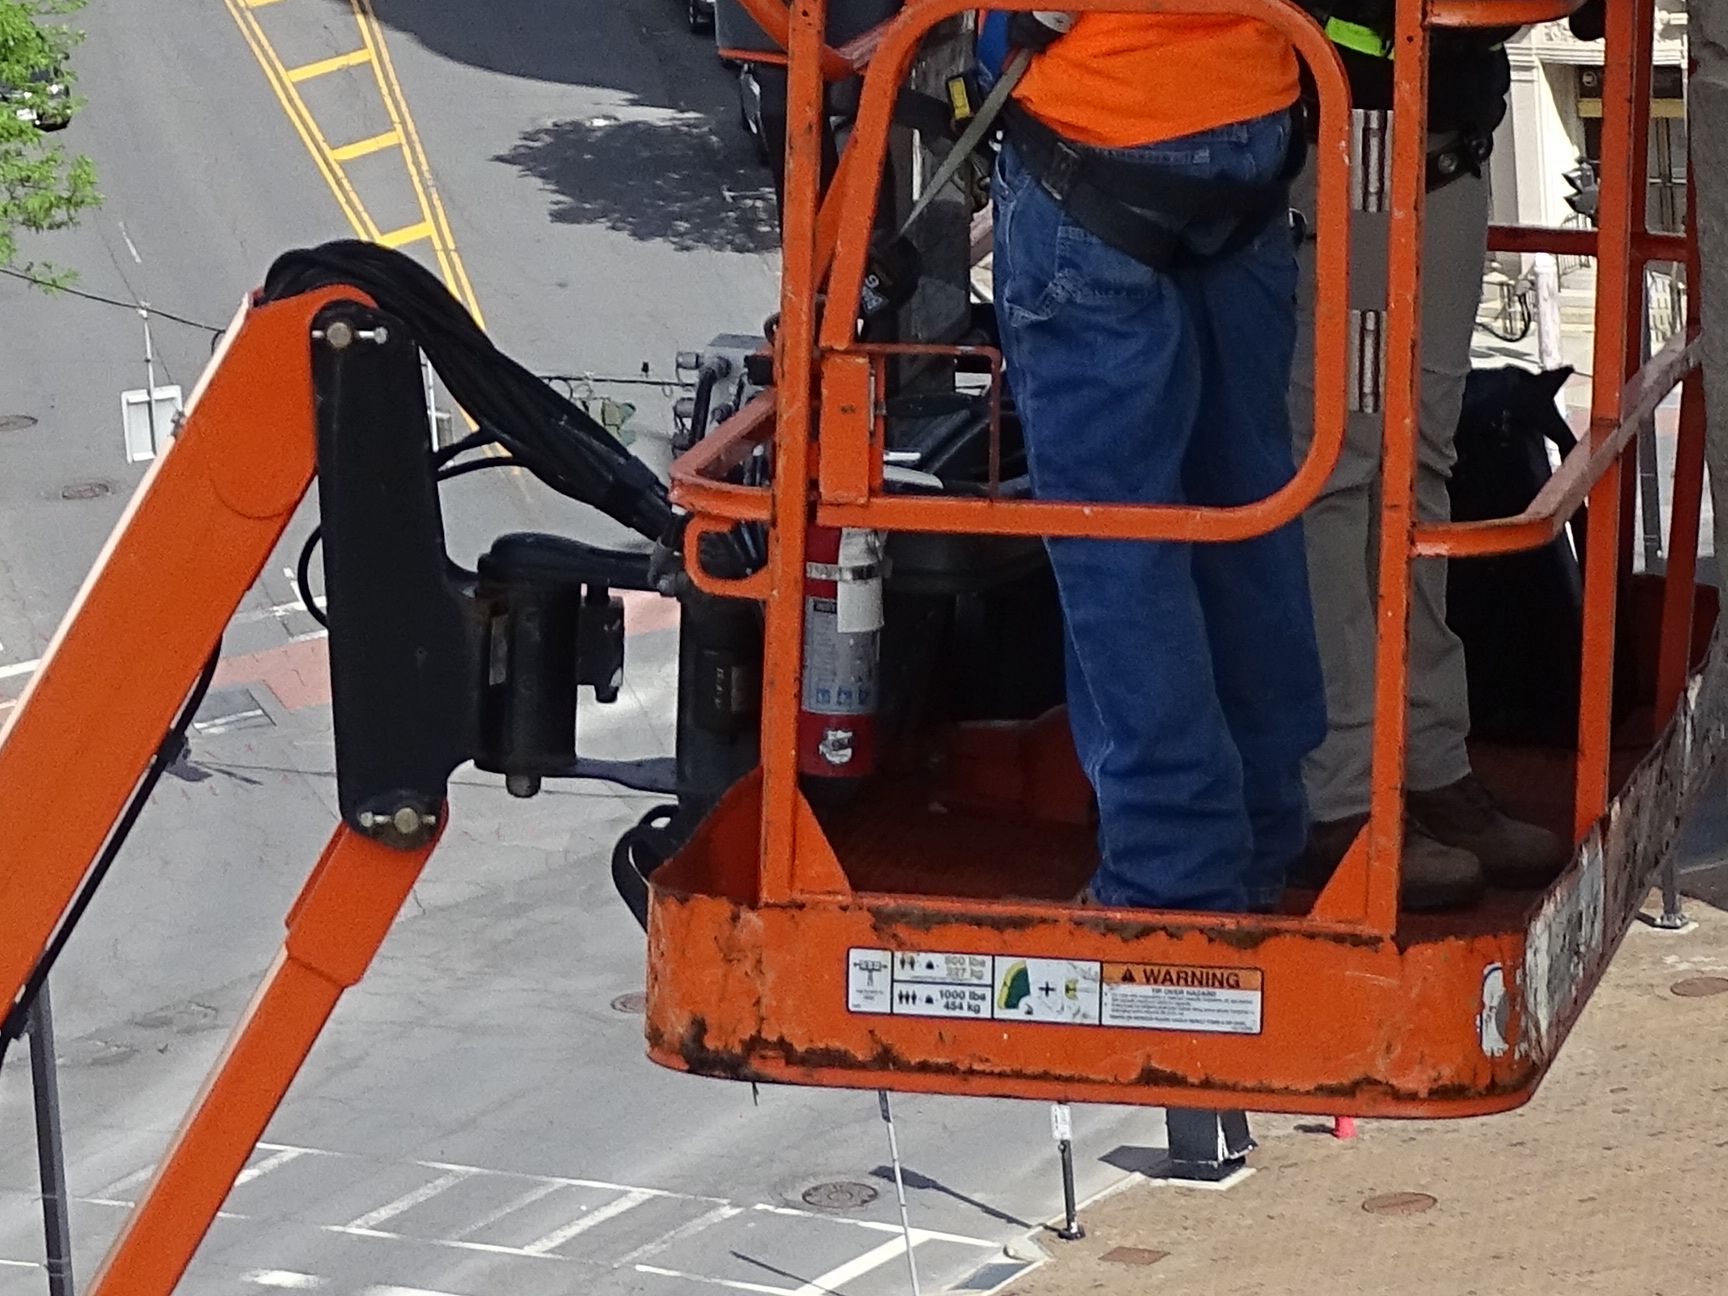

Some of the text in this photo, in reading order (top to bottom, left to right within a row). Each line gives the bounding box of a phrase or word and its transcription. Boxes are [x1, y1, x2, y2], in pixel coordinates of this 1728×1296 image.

[1142, 968, 1241, 988] WARNING
[939, 989, 986, 1001] 1000 lbs
[943, 1001, 981, 1014] 454 kg
